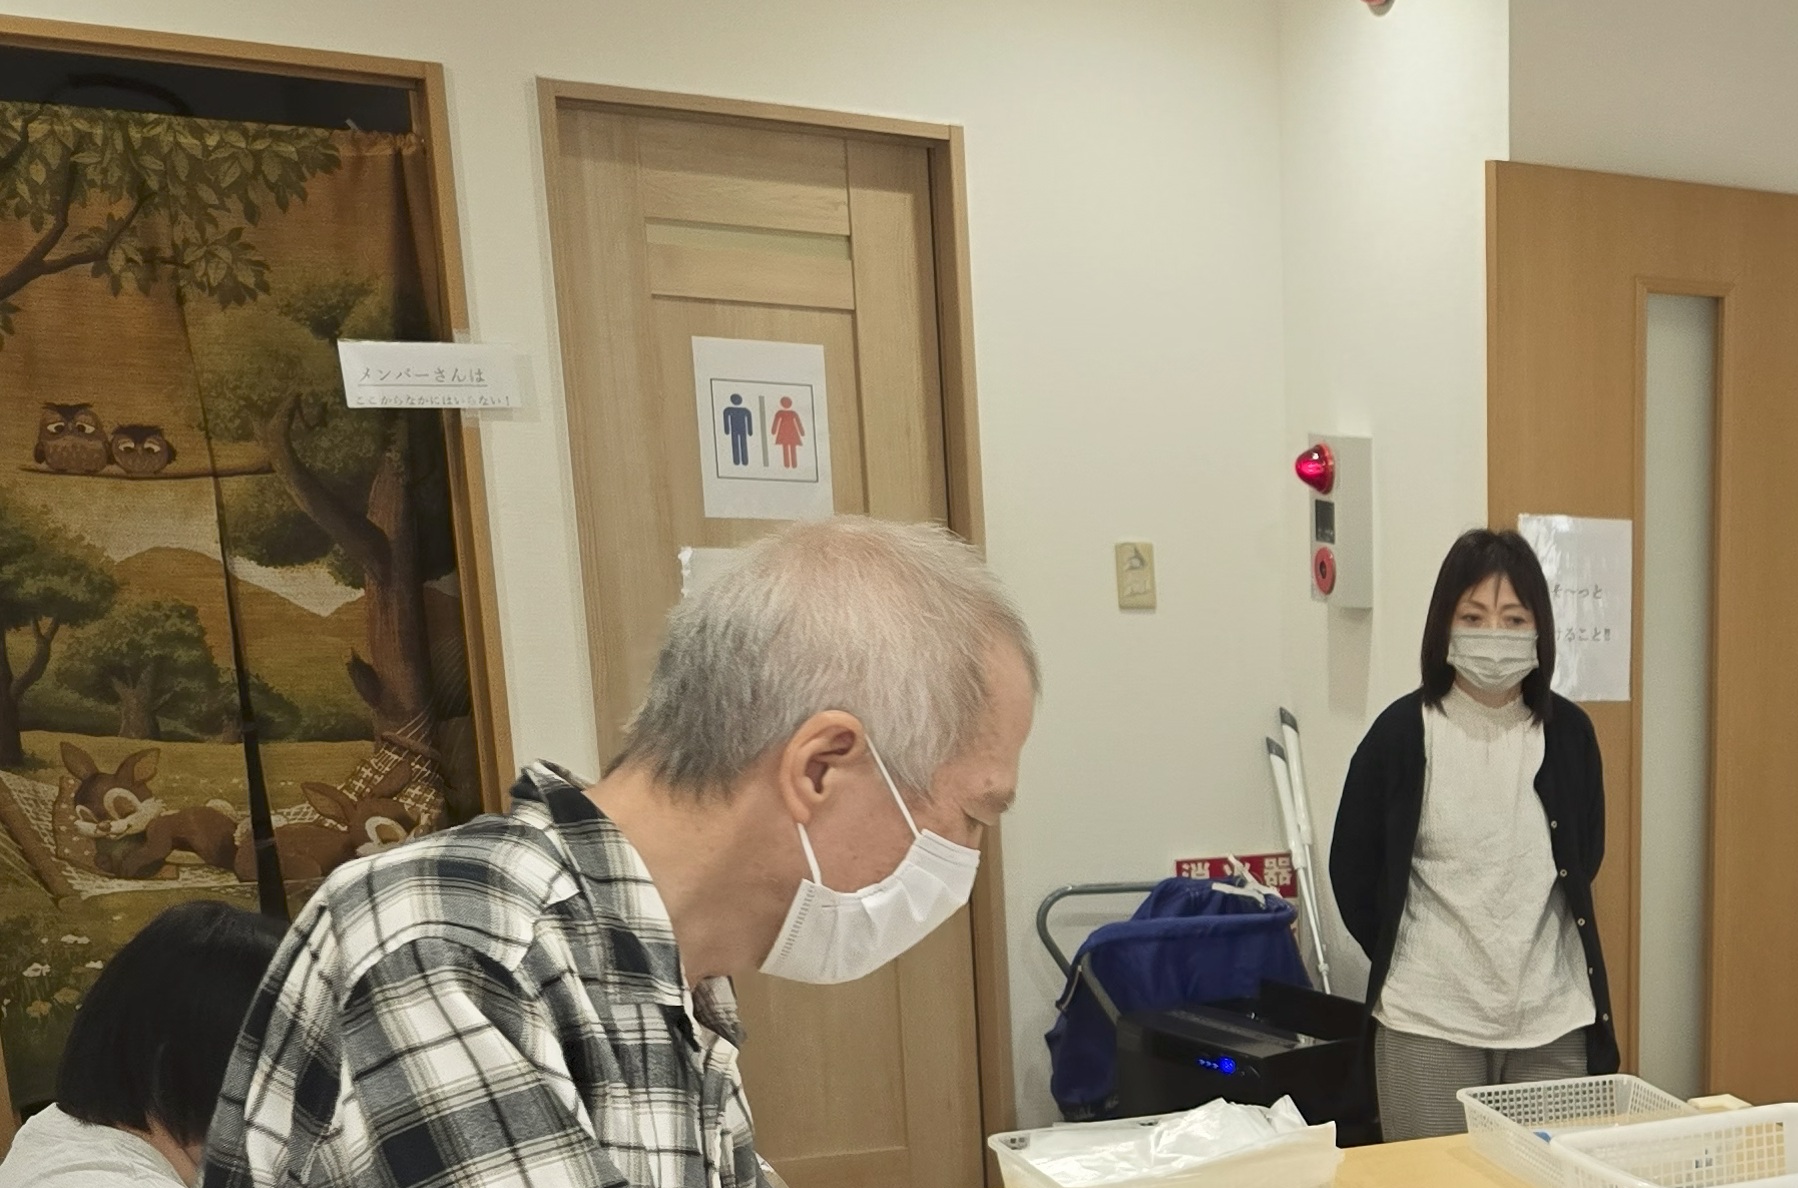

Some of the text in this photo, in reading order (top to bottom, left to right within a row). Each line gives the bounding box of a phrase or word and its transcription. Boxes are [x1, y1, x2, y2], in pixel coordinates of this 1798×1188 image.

[359, 367, 486, 383] メンバーさんは
